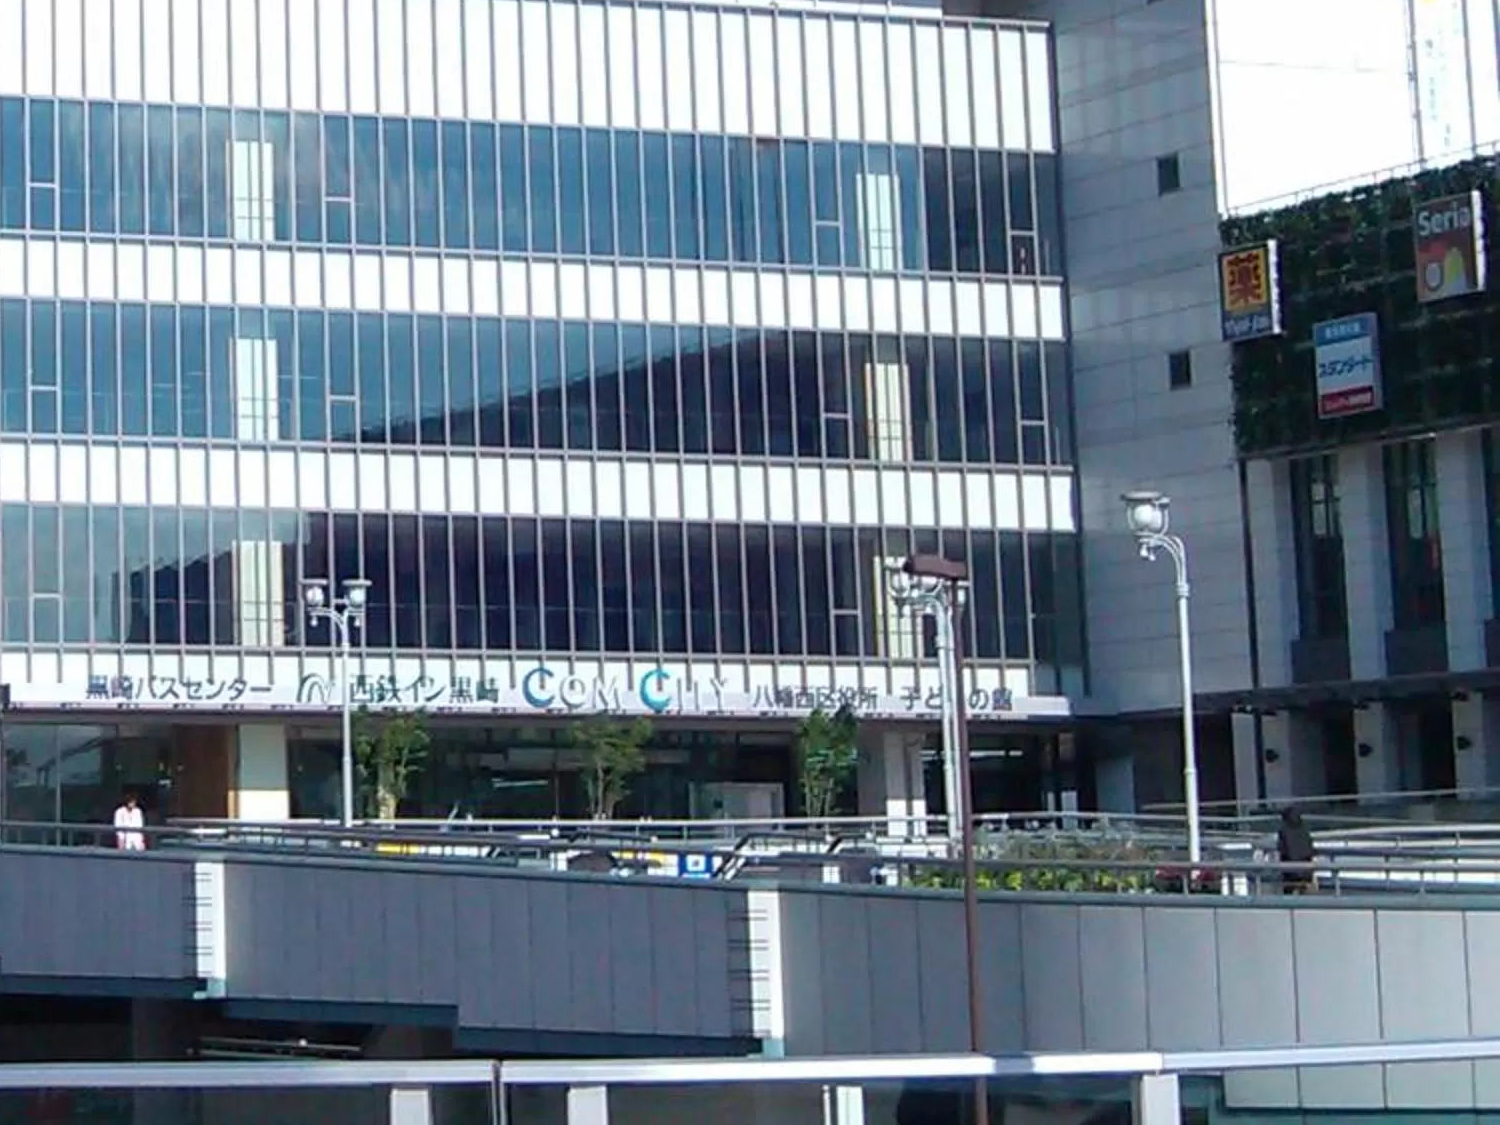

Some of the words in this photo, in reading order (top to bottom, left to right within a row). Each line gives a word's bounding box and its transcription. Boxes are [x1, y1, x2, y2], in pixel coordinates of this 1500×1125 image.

[1418, 200, 1471, 236] Seria
[86, 675, 272, 702] 黒崎バスセンター
[522, 667, 622, 711] COM
[639, 668, 728, 712] CITY
[753, 684, 878, 710] 八幡西区役所
[901, 685, 1013, 711] 子どの館
